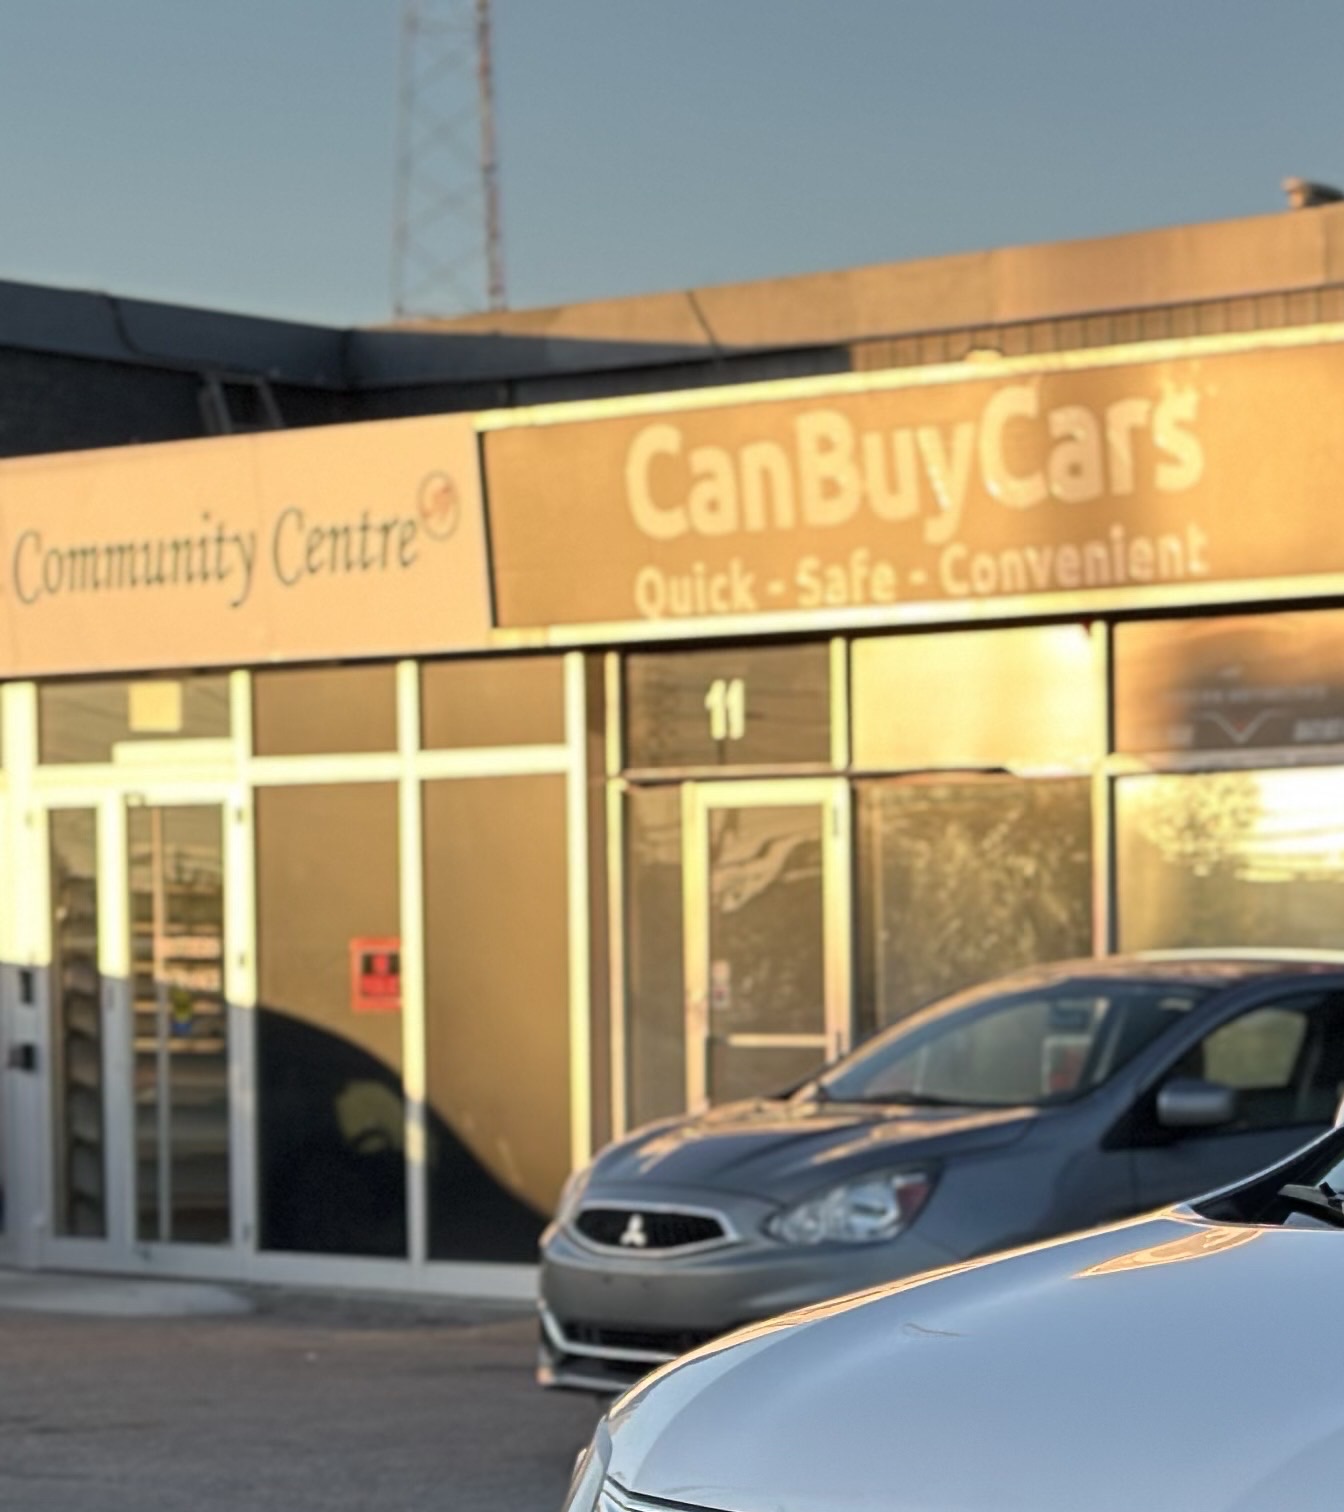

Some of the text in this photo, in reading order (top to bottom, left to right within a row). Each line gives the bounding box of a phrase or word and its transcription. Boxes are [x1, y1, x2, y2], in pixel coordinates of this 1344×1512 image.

[624, 383, 1206, 546] CanBuyCars
[12, 506, 420, 609] Community Centre
[634, 557, 757, 621] Quick
[795, 547, 897, 608] Safe
[938, 520, 1211, 597] Convenient
[703, 678, 746, 741] 11
